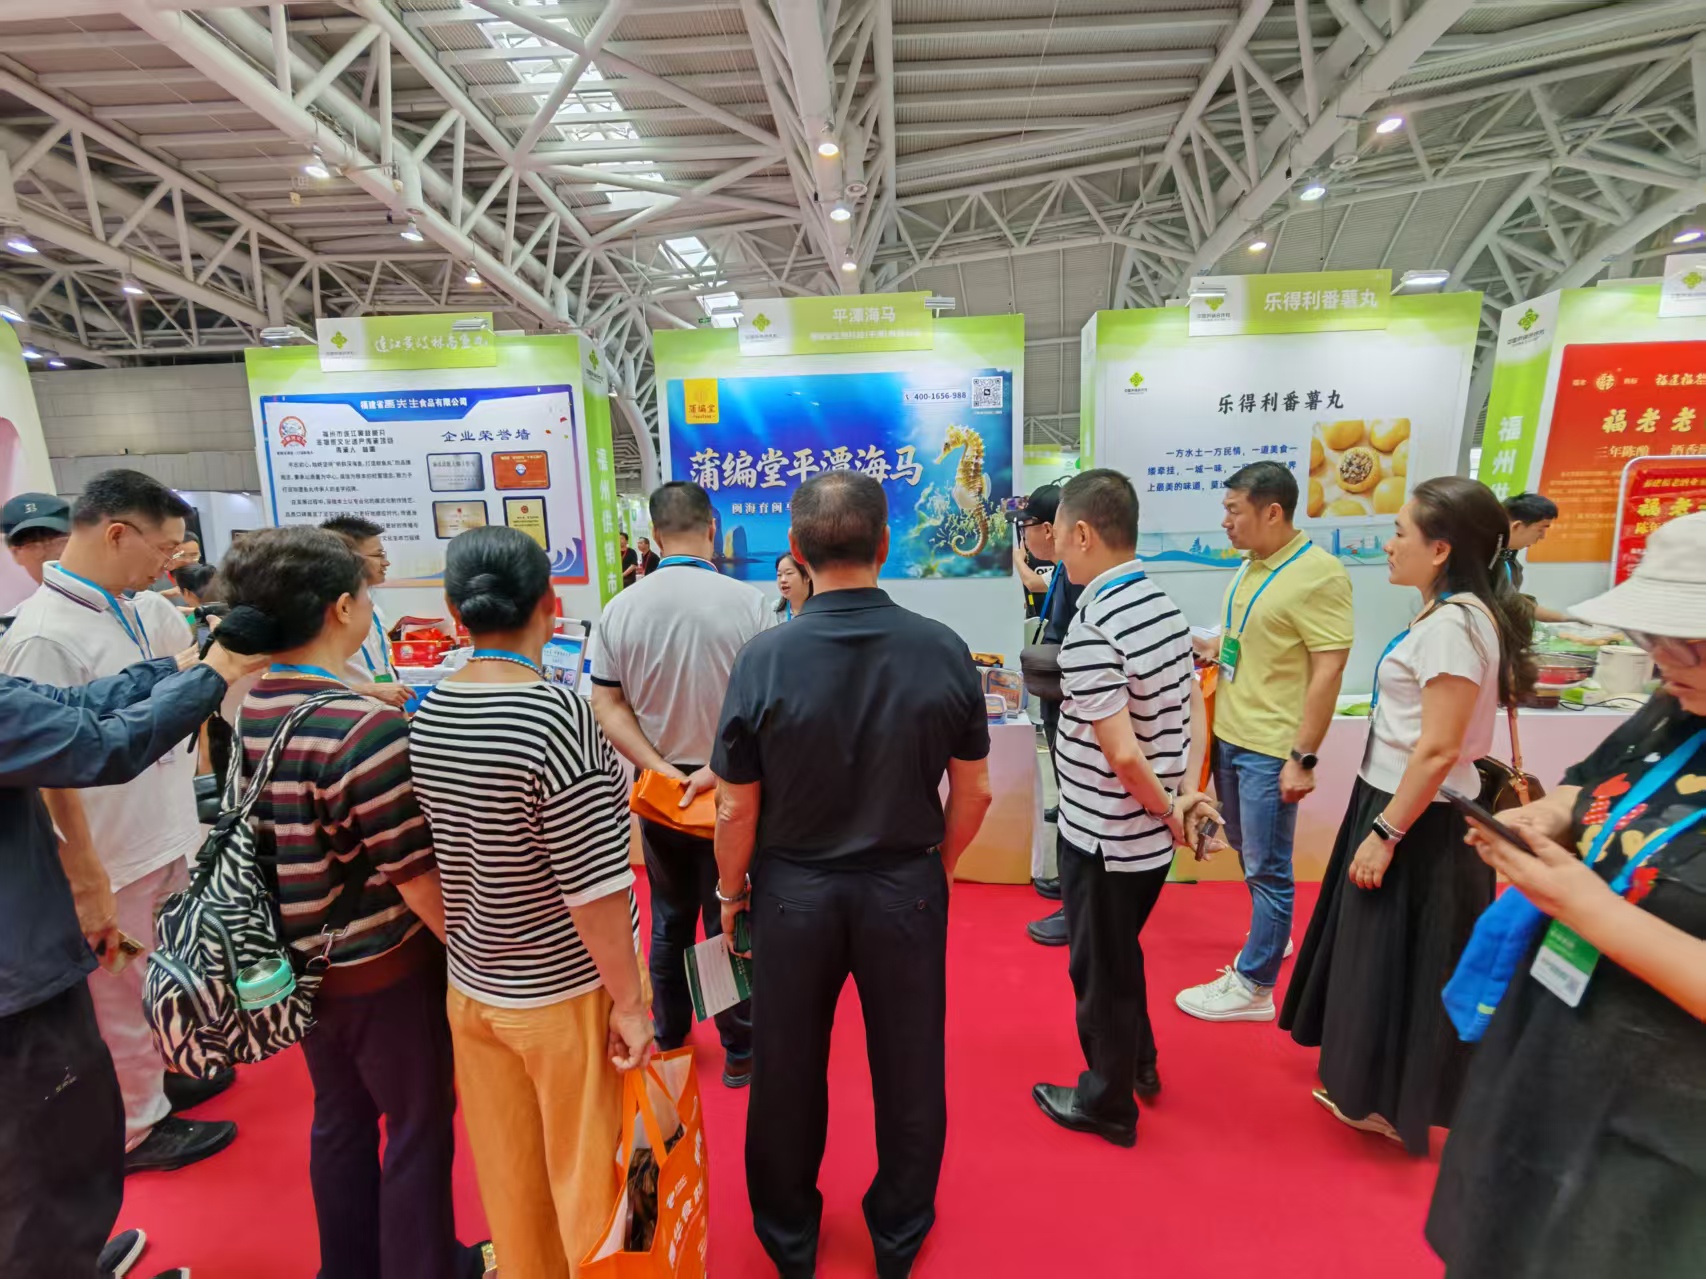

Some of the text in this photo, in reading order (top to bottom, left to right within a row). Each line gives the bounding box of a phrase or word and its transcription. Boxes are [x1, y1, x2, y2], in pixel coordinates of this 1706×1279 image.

[1263, 288, 1379, 313] 乐得利番薯丸
[832, 306, 896, 324] 平潭海马
[914, 391, 967, 401] 400-1656-988
[1216, 389, 1346, 415] 乐得利番薯丸
[440, 426, 531, 444] 企业荣誉墙
[689, 443, 924, 492] 蒲编堂平潭海马
